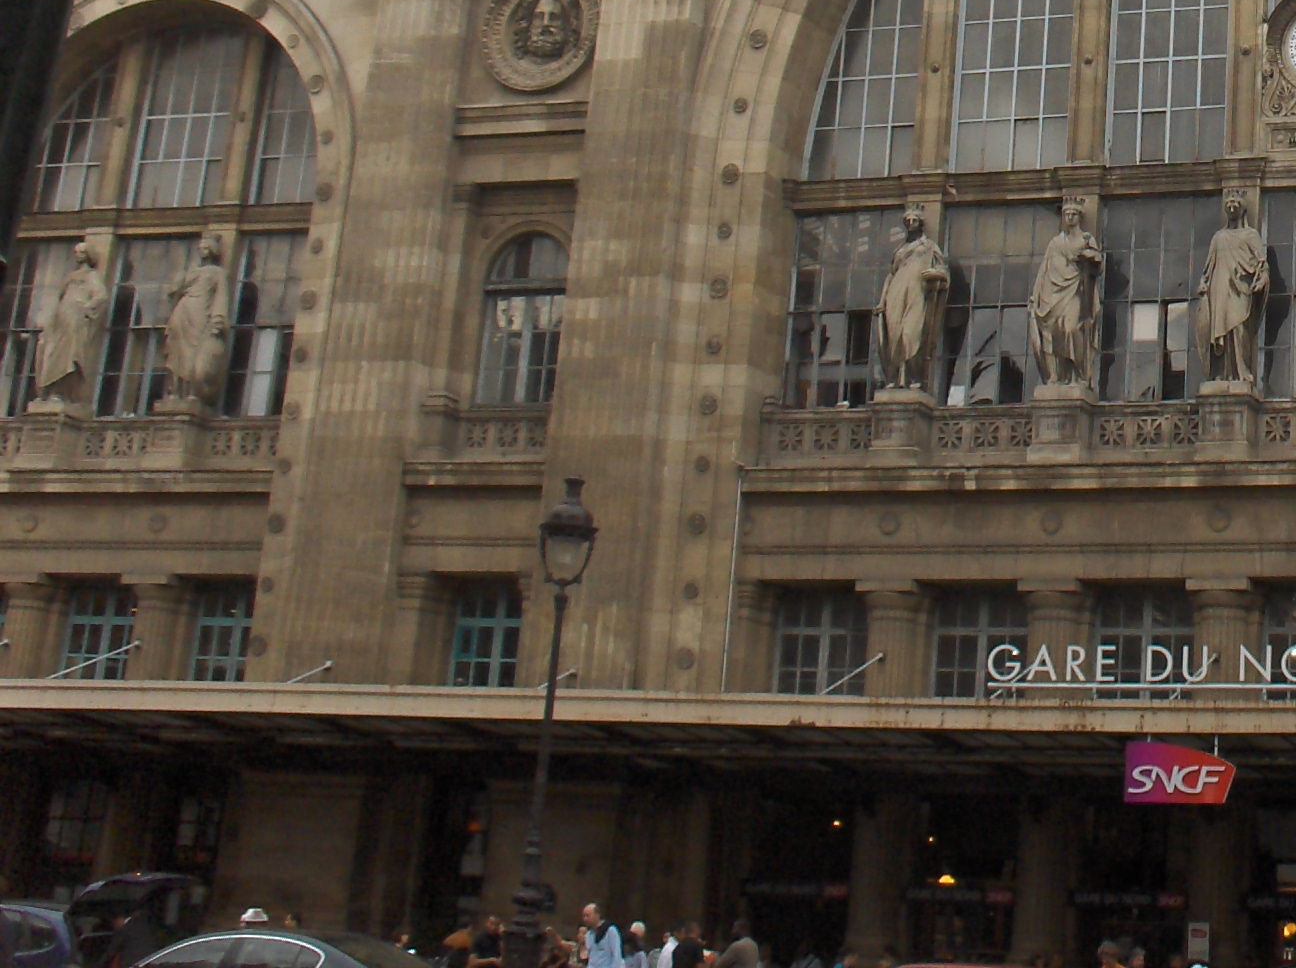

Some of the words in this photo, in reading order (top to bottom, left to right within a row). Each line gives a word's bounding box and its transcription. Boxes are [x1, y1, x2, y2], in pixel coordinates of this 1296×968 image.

[987, 644, 1117, 683] GARE
[1146, 644, 1209, 683] DU
[1127, 765, 1227, 795] SNCF
